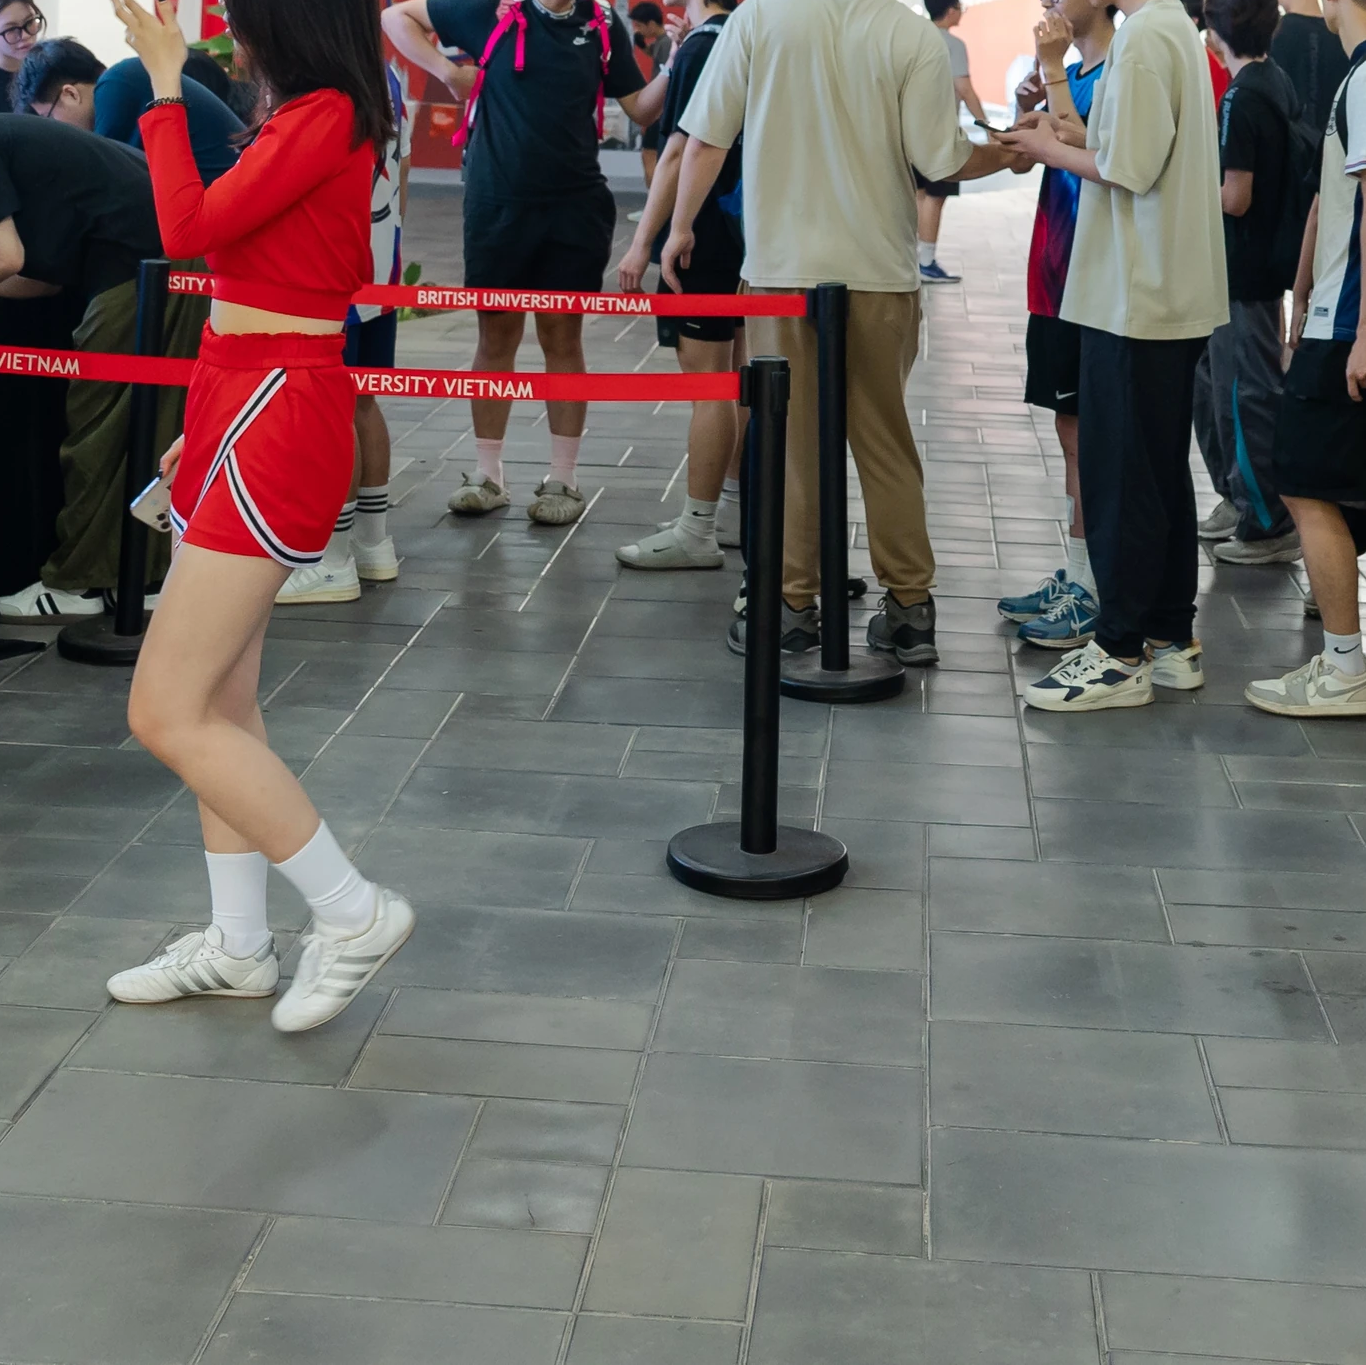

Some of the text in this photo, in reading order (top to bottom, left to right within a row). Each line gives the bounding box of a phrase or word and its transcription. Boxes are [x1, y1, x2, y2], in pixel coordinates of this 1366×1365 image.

[417, 290, 652, 313] BRITISH UNIVERSITY VIETNAM
[350, 373, 534, 399] VERSITY VIETNAM
